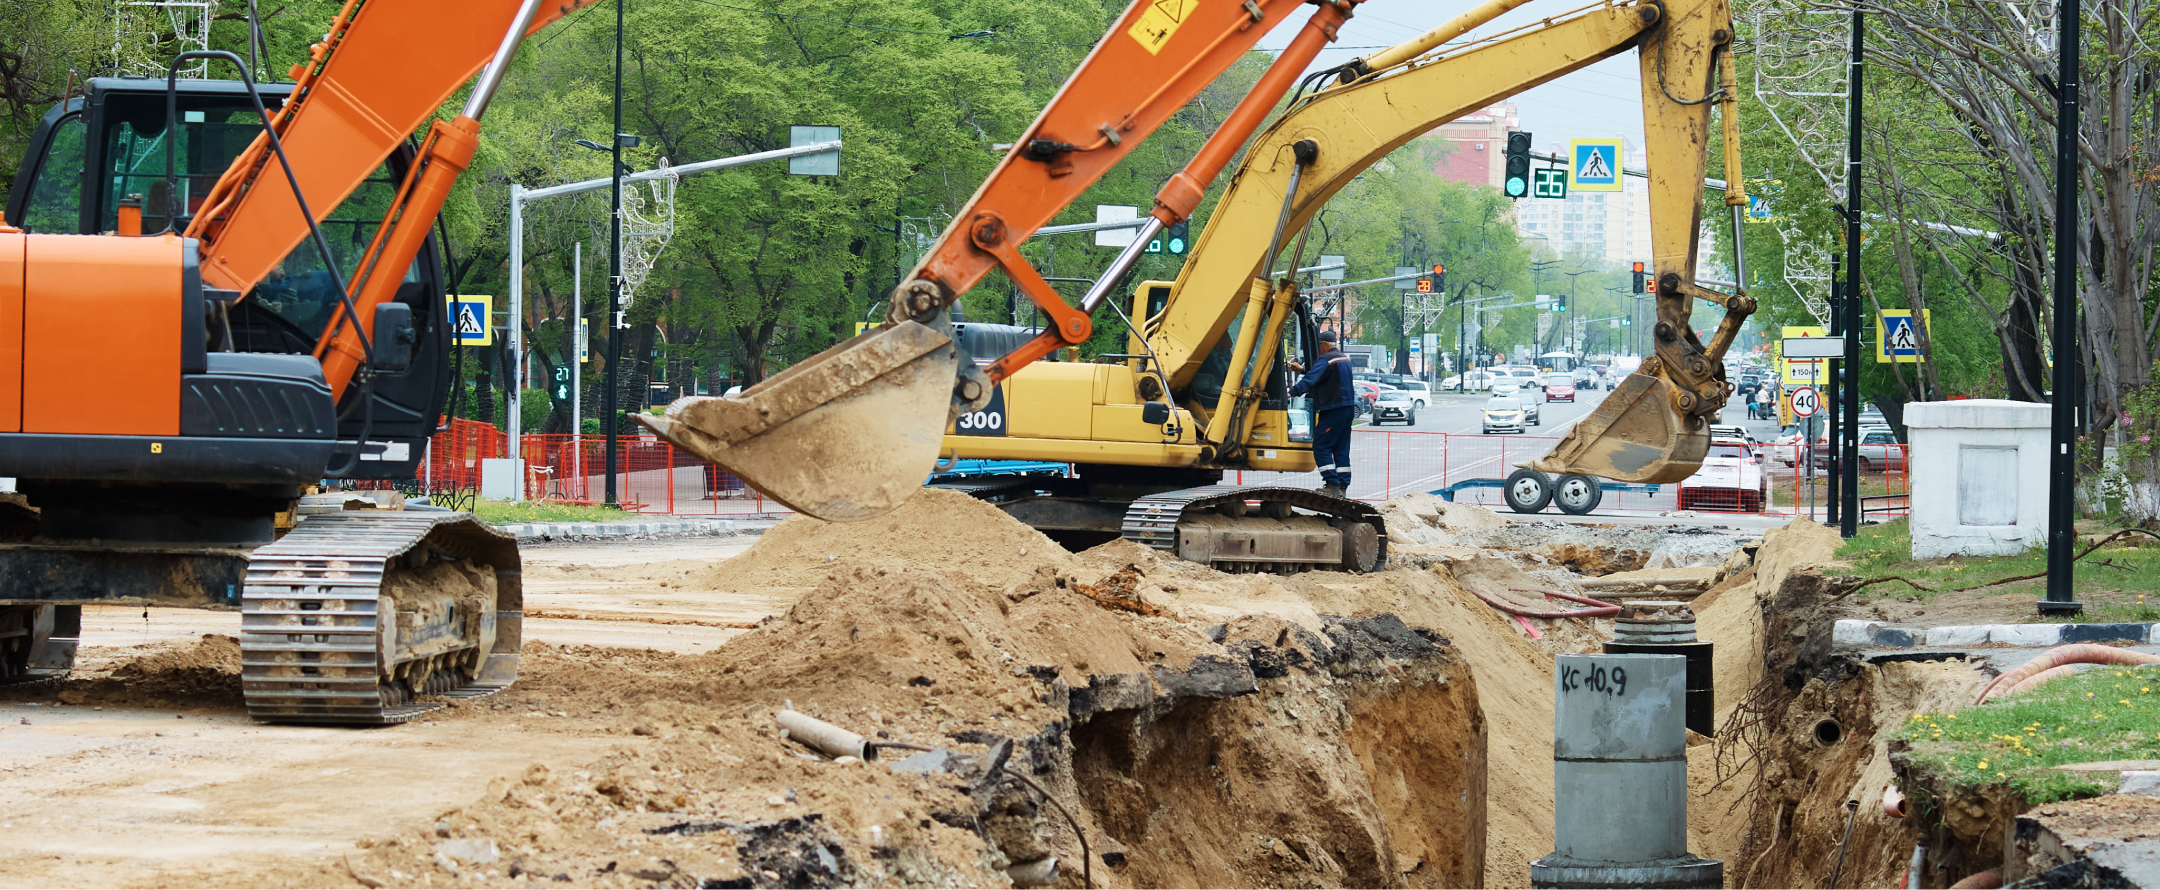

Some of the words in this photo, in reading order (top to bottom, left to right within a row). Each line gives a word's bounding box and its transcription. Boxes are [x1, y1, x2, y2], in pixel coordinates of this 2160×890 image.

[1536, 171, 1563, 196] 26
[1417, 280, 1431, 292] 28
[556, 368, 569, 380] 27
[1796, 395, 1812, 408] 40
[960, 411, 1001, 429] 300
